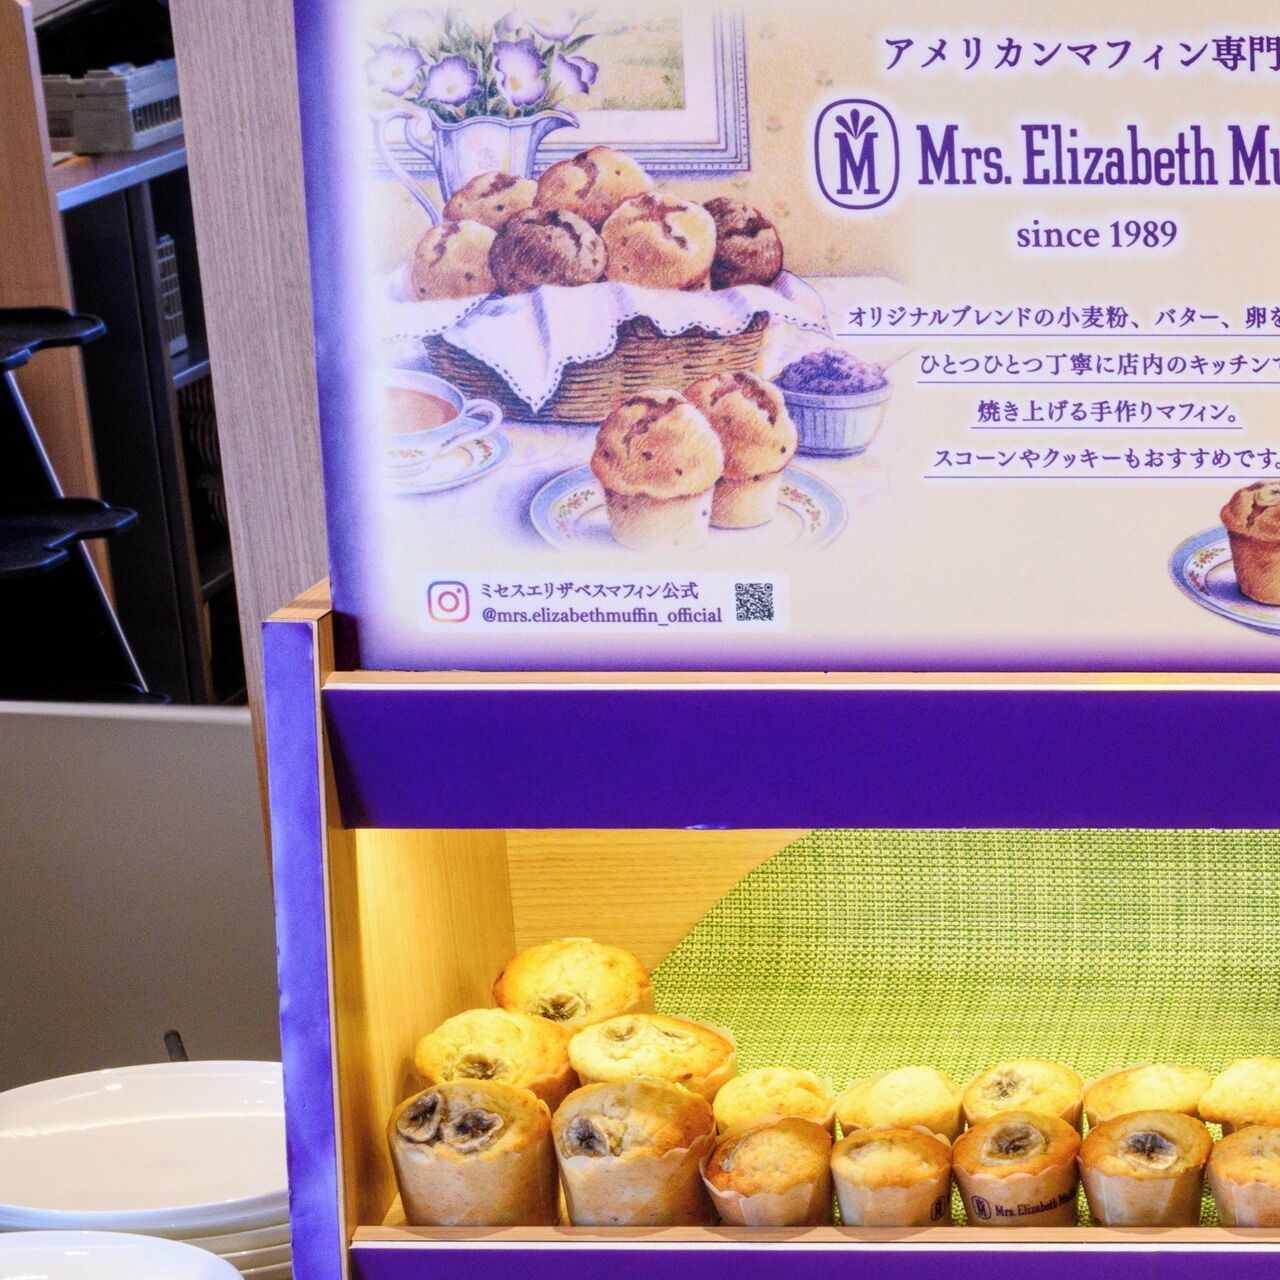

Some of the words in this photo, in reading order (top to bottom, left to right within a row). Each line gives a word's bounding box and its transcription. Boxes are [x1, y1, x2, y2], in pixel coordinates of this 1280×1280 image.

[916, 124, 1012, 186] Mrs.
[1021, 124, 1218, 187] Elizabeth
[1016, 220, 1100, 249] since
[1110, 220, 1178, 249] 1989
[977, 399, 1241, 424] 焼き上げる手作りマフィン。
[480, 581, 700, 600] ミセスエリザベスマフィン公式
[481, 607, 724, 627] @mrs.elizabethmuffin_official
